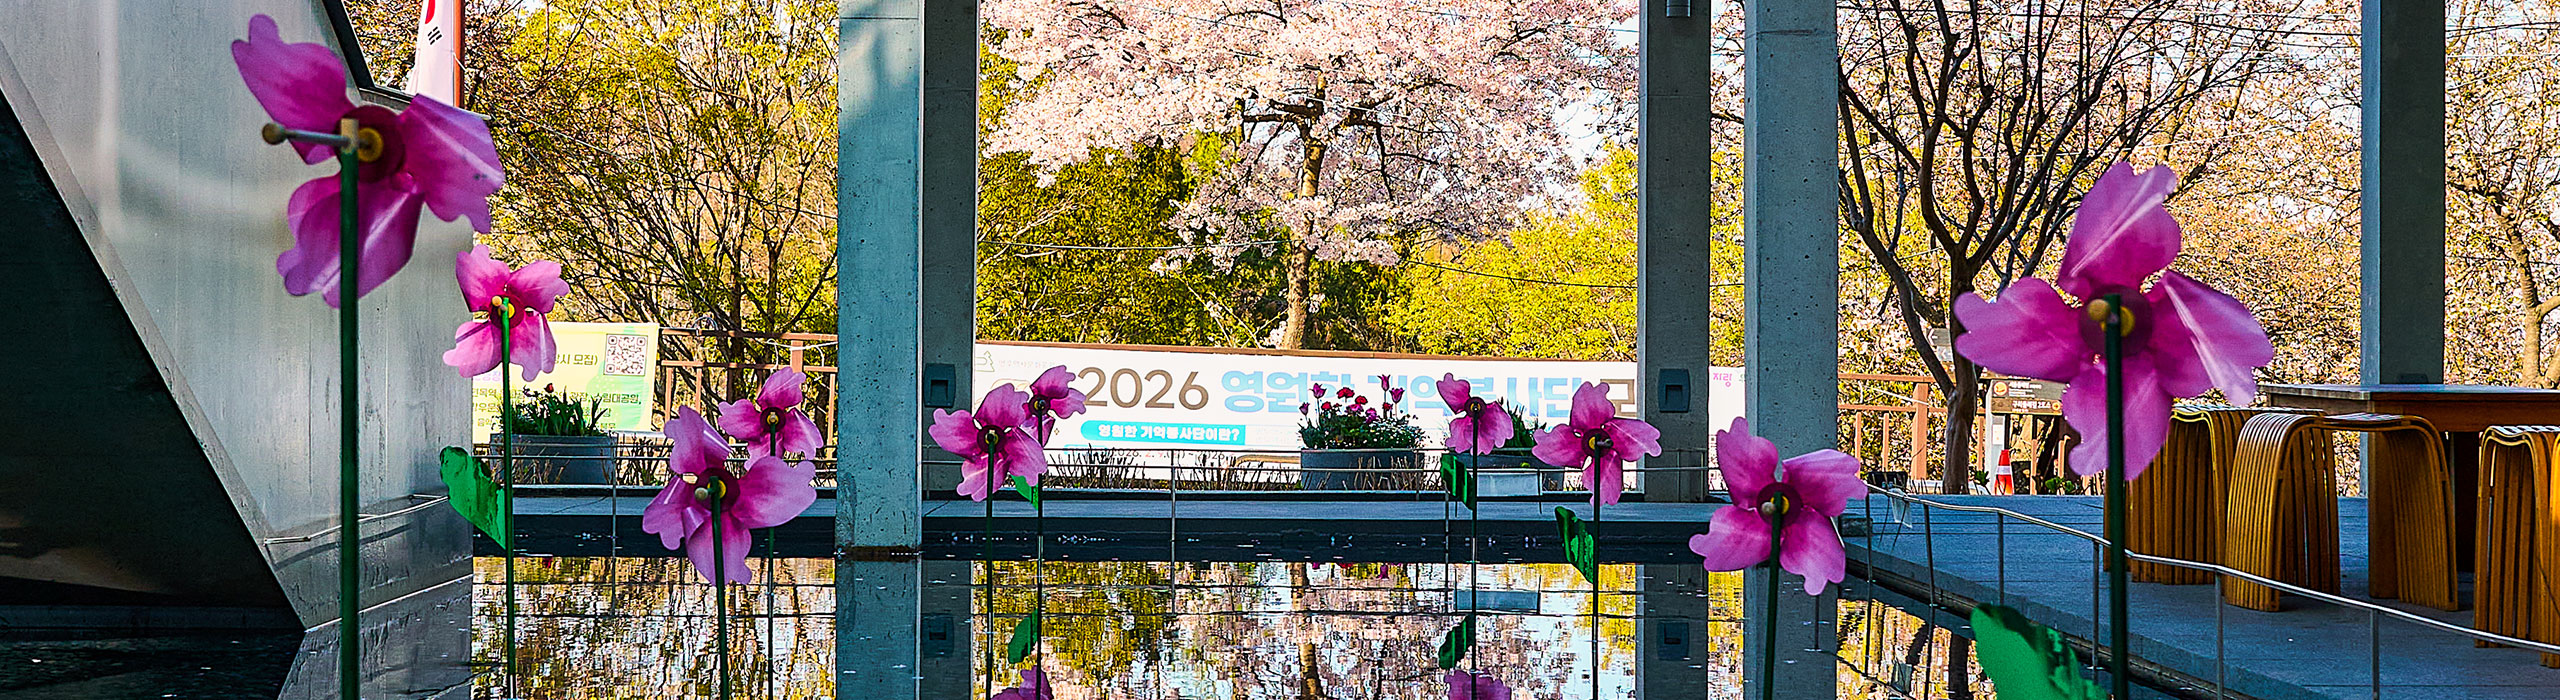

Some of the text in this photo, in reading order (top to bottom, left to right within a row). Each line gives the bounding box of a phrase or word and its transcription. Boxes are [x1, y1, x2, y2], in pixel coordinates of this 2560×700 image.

[573, 353, 598, 365] 모집)
[1077, 366, 1209, 410] 2026
[1098, 424, 1137, 438] 영원한
[1140, 425, 1239, 441] 기억봉사단이란?
